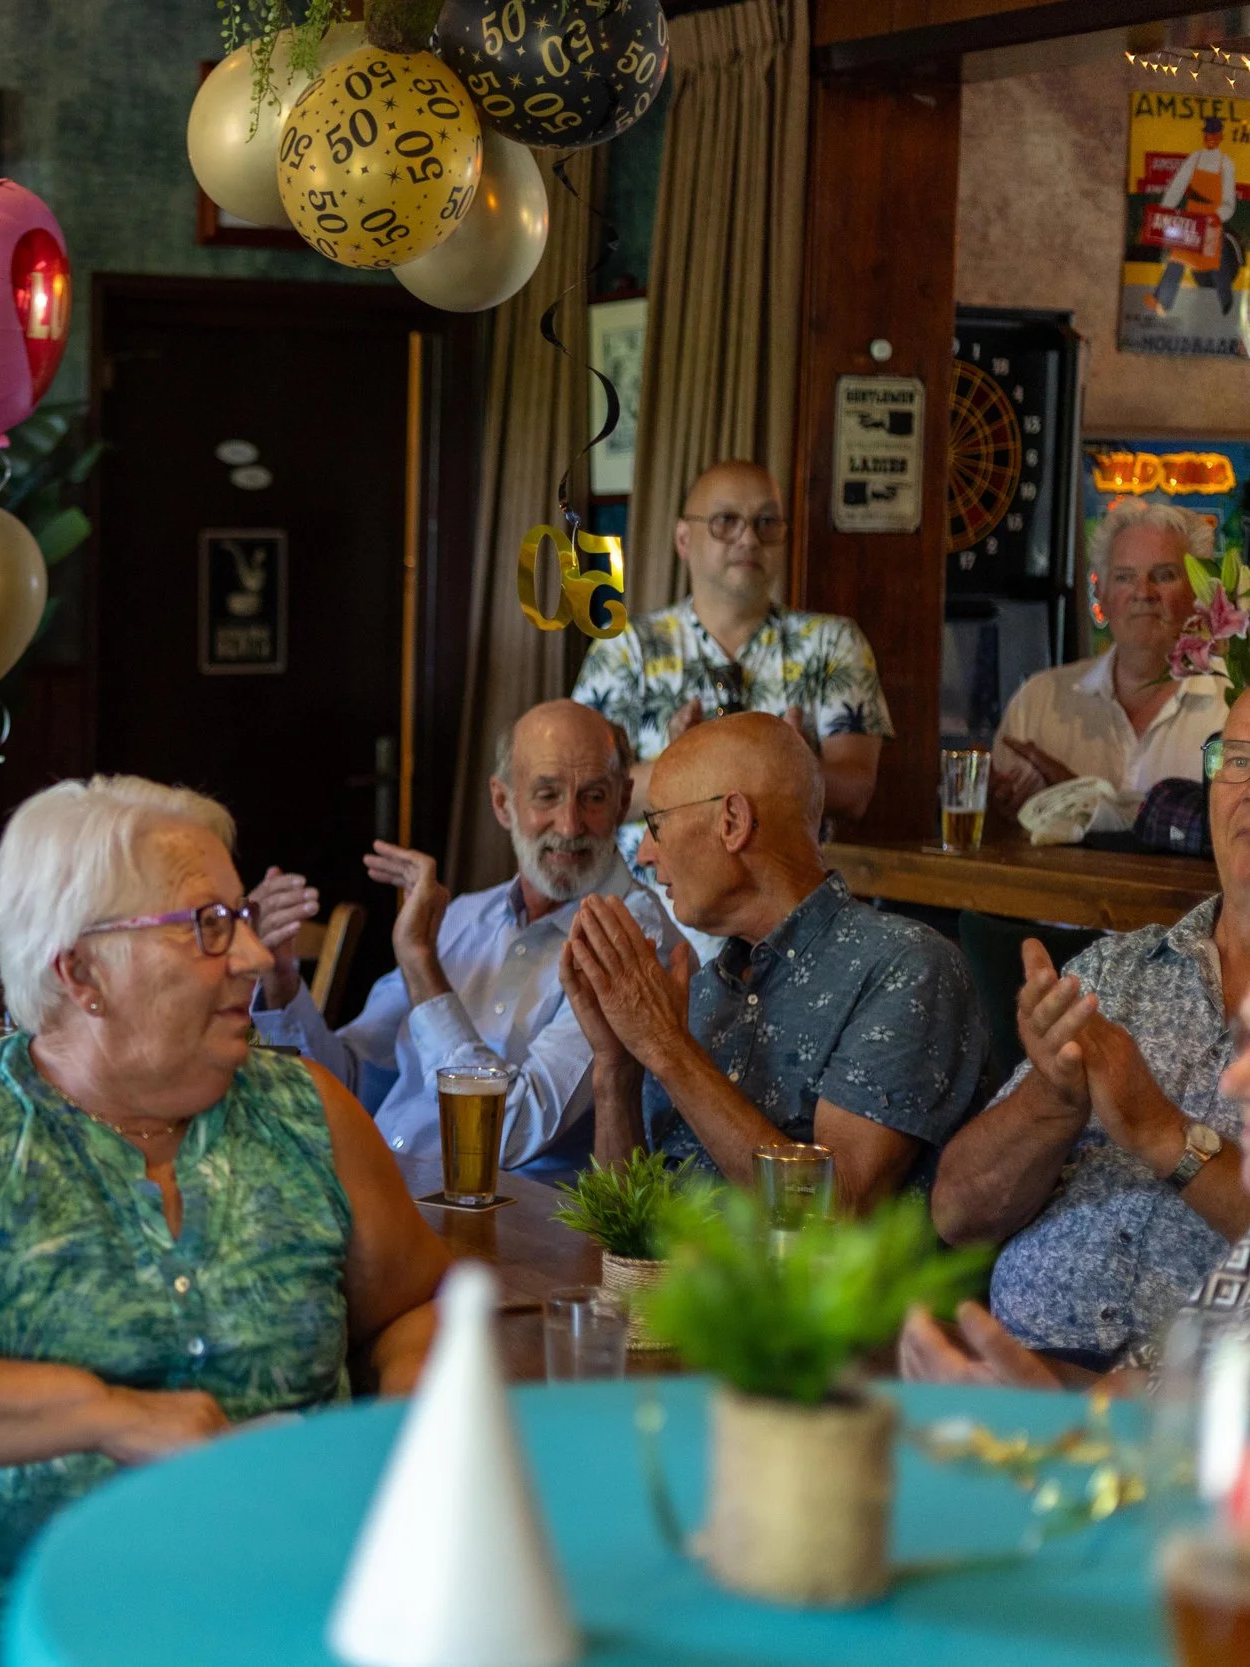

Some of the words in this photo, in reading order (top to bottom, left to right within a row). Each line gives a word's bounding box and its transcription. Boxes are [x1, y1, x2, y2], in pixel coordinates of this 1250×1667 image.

[481, 0, 526, 56] 50
[541, 19, 595, 78] 50
[345, 60, 398, 101] 50
[616, 40, 657, 84] 50
[412, 78, 461, 120] 50
[468, 71, 516, 117] 50
[523, 92, 582, 134] 50
[1134, 93, 1243, 123] AMSTEL
[325, 108, 379, 165] 50
[394, 130, 444, 185] 50
[308, 189, 349, 234] 50
[440, 184, 474, 221] 50
[360, 208, 410, 248] 50
